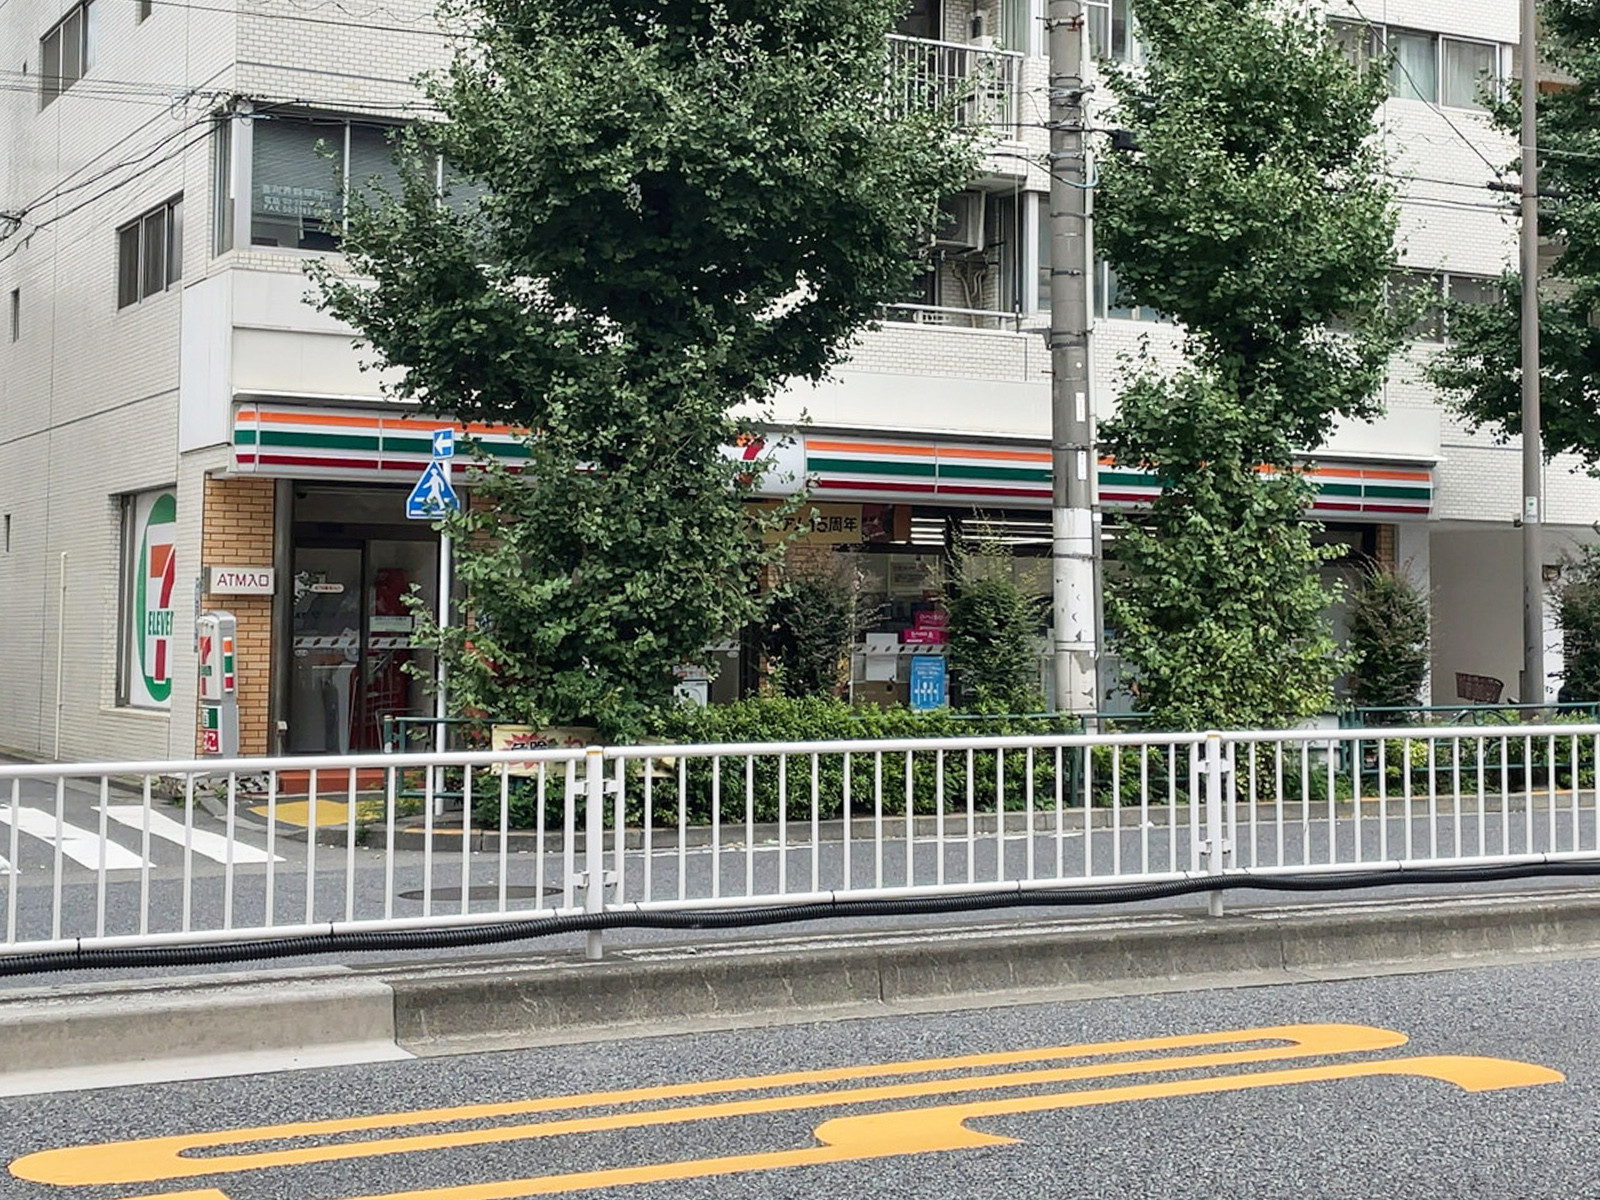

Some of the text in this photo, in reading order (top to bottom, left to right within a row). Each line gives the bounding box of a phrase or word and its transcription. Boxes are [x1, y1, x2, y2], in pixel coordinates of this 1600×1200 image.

[742, 516, 858, 533] ア15周年
[216, 572, 269, 587] ATM入口
